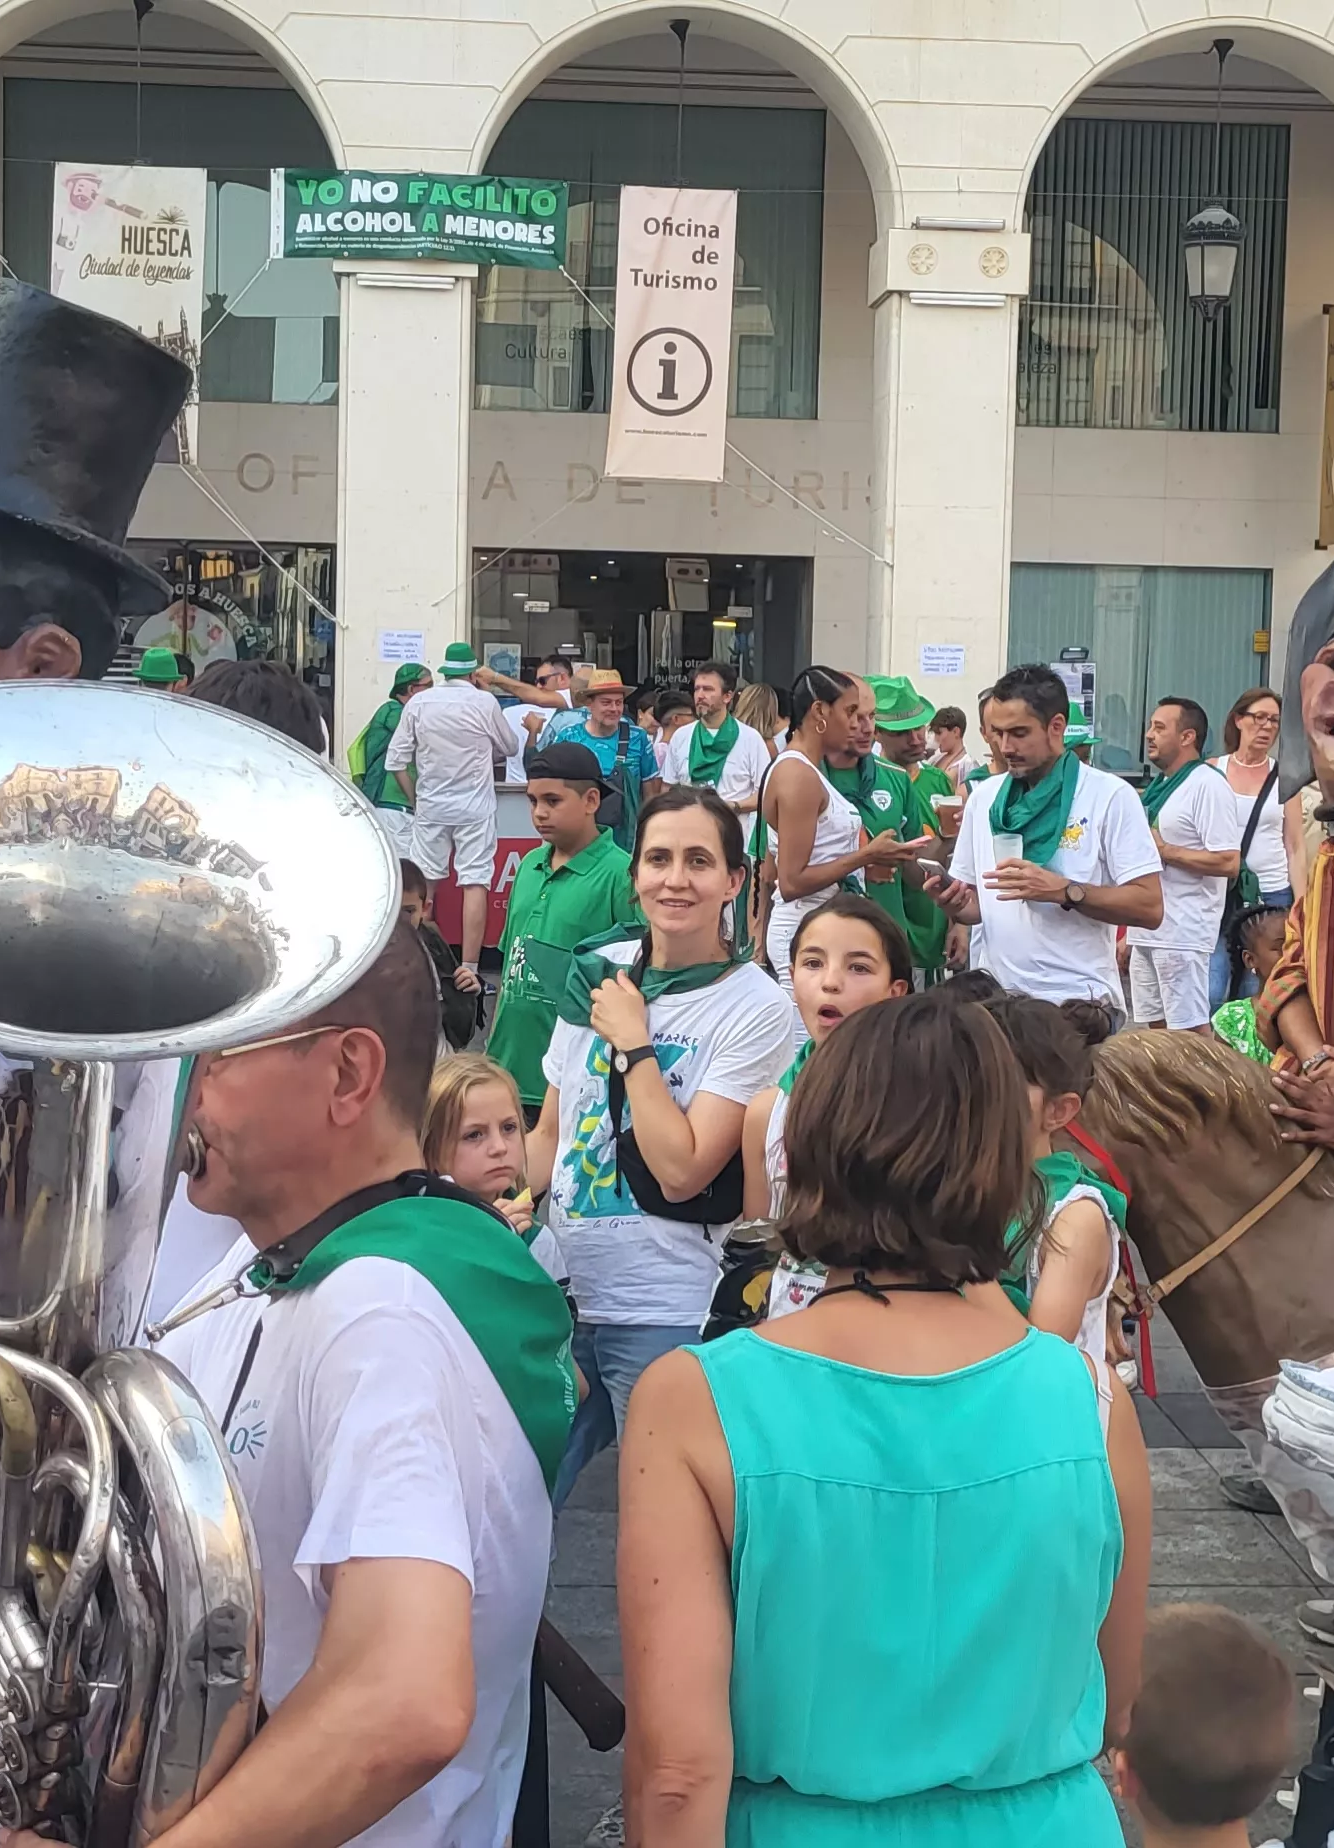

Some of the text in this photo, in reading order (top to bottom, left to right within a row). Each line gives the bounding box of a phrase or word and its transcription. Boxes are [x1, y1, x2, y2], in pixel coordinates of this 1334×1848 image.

[296, 178, 557, 217] YO NO FACILITO
[295, 210, 556, 245] ALCOHOL A MENORES
[643, 216, 720, 239] Oficina
[120, 225, 192, 258] HUESCA
[691, 245, 719, 265] de
[79, 254, 195, 286] Ciudad de leyendas
[630, 268, 718, 292] Turismo
[505, 343, 567, 360] Cultura
[198, 587, 212, 599] A
[214, 592, 259, 649] HUESCA
[674, 656, 683, 669] la
[654, 674, 691, 686] puerta,
